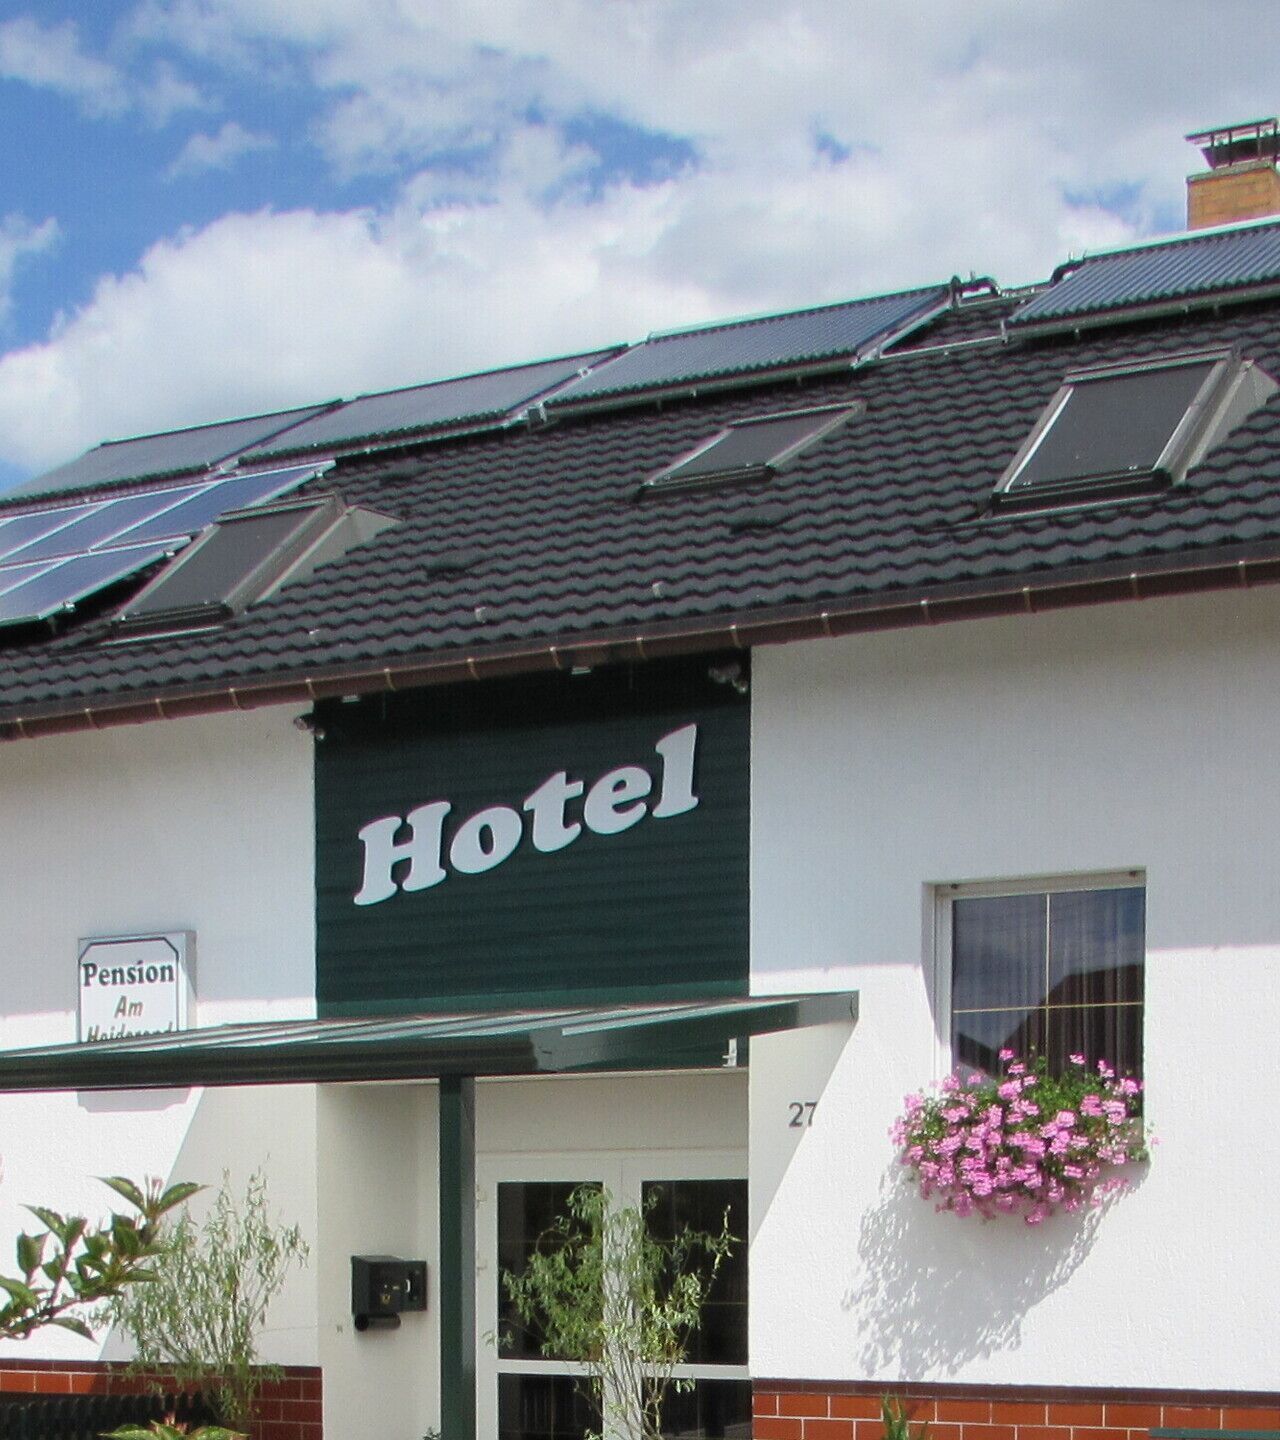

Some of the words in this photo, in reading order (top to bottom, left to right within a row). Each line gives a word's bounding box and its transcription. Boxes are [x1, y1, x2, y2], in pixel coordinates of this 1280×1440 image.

[353, 722, 699, 906] Hotel
[82, 960, 174, 986] Pension
[114, 995, 144, 1019] Am
[789, 1102, 817, 1127] 27
